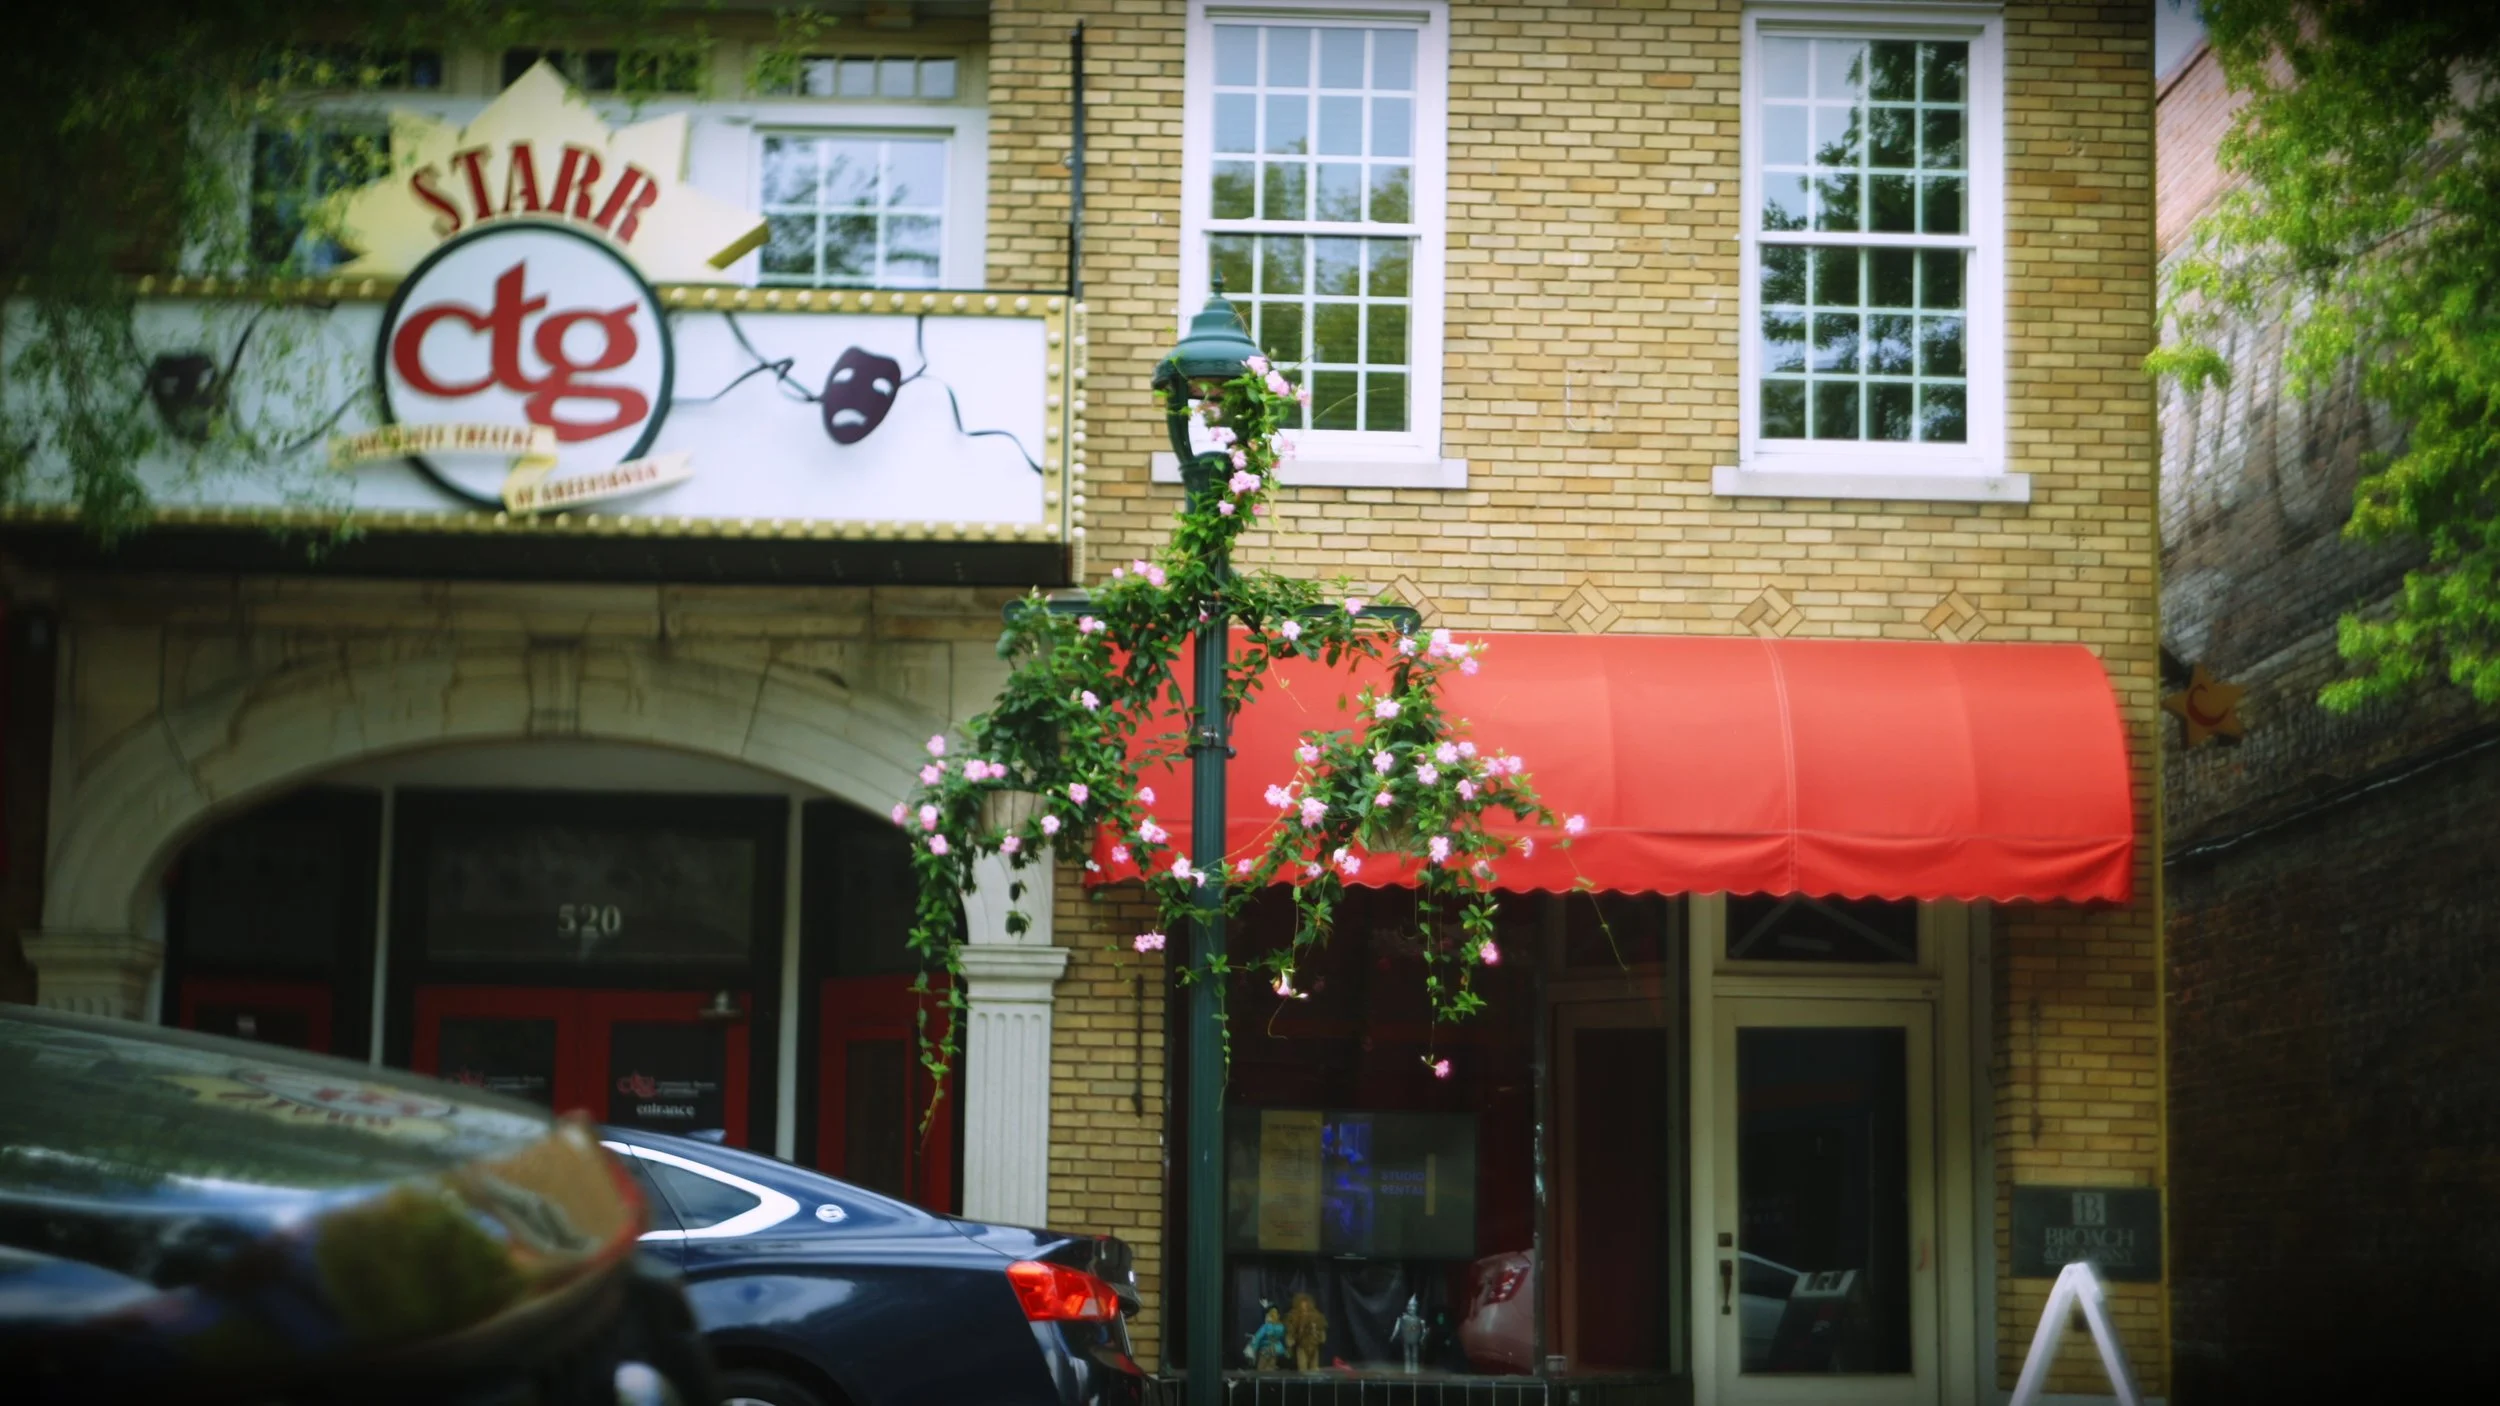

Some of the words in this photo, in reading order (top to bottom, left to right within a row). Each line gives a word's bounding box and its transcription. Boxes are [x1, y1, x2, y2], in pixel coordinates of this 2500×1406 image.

[409, 139, 659, 245] STARR
[393, 258, 648, 442] ctg
[555, 902, 623, 939] 520
[636, 1102, 696, 1119] entrance
[2045, 1227, 2134, 1247] BROACH
